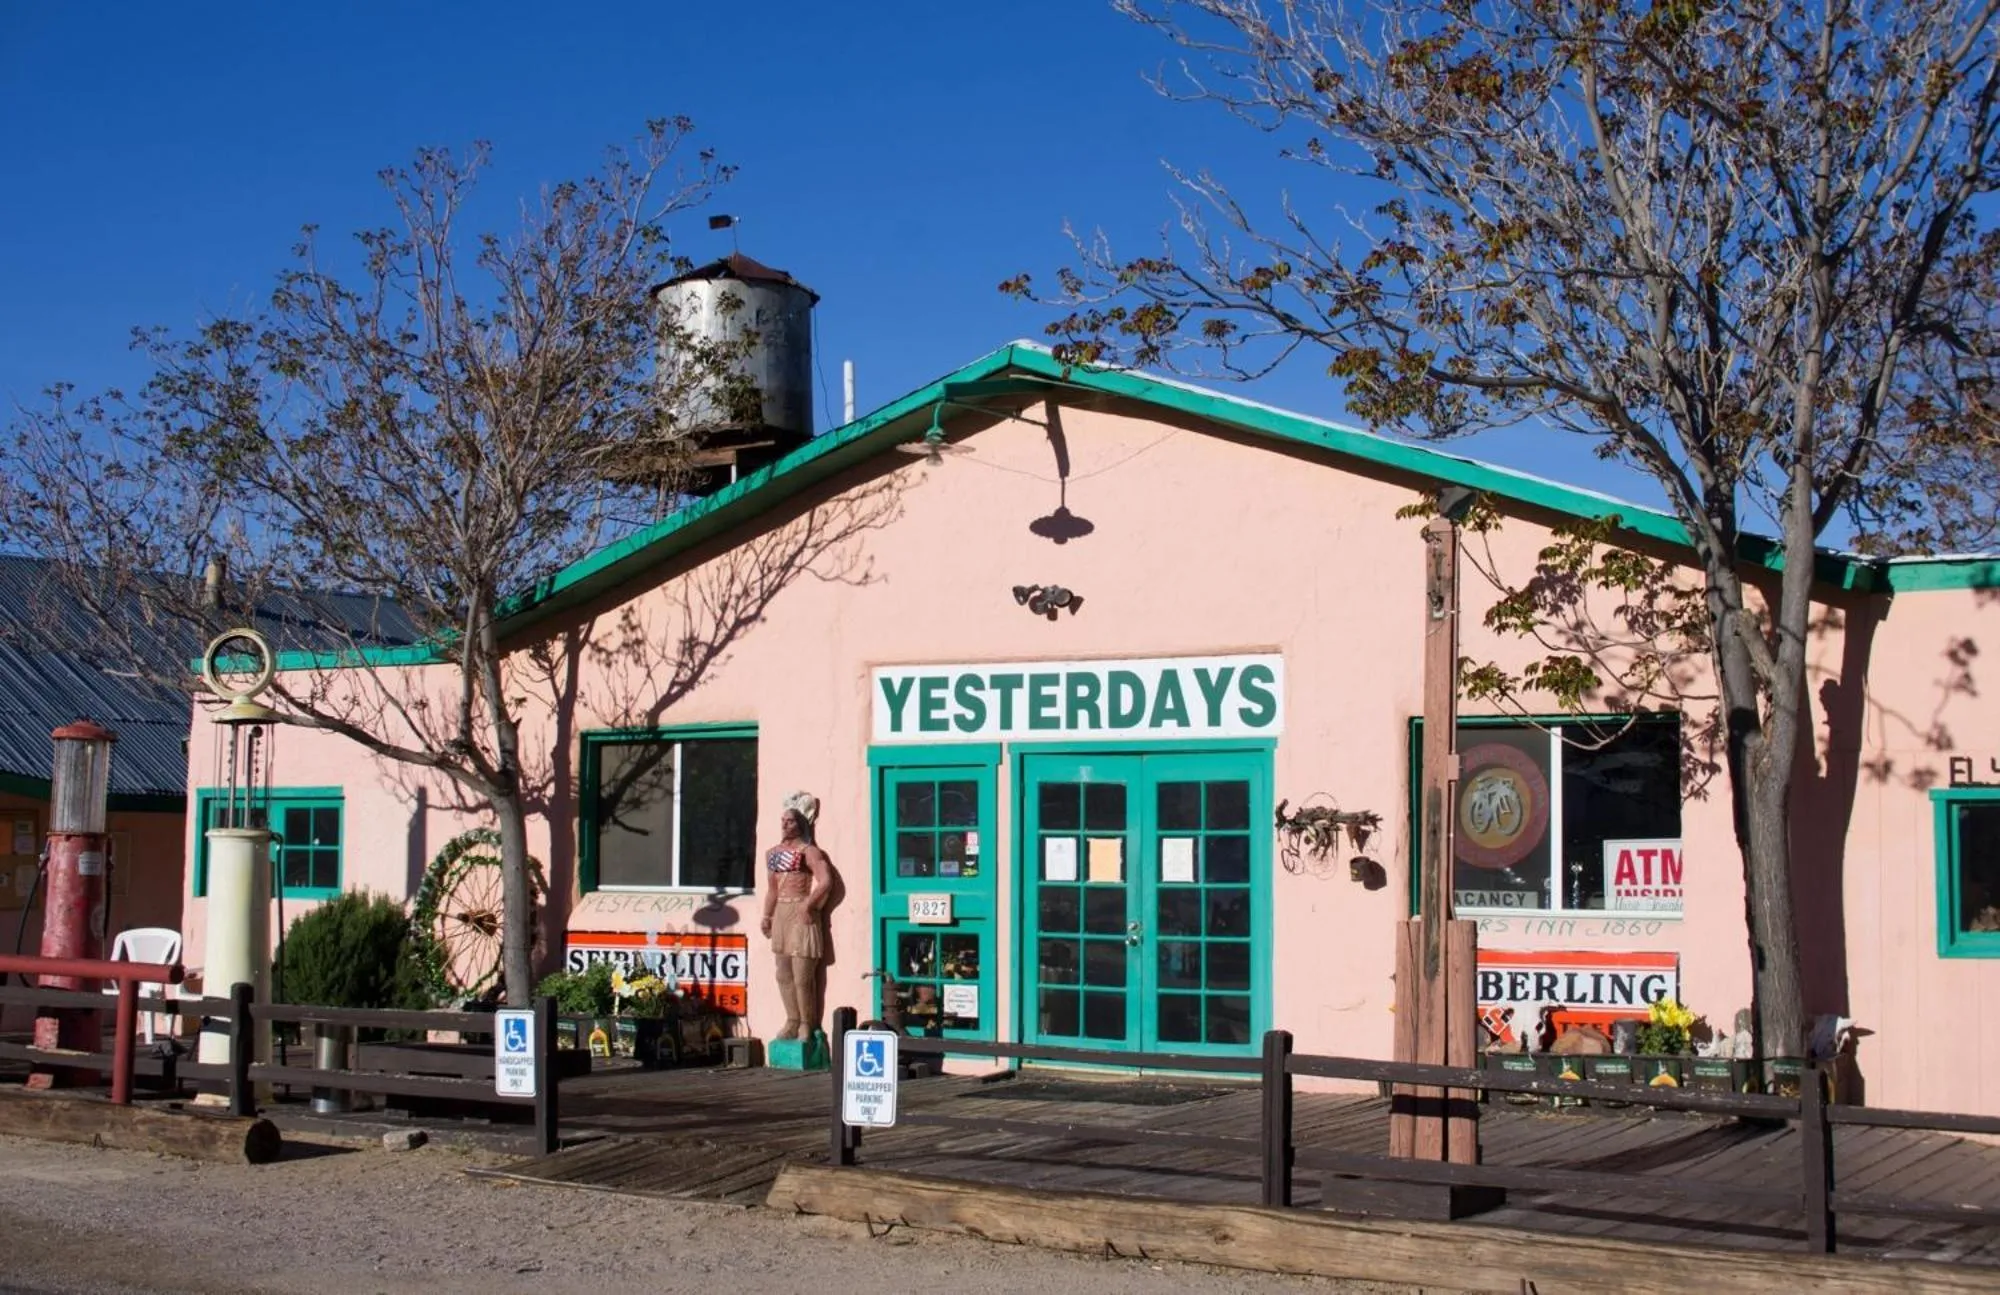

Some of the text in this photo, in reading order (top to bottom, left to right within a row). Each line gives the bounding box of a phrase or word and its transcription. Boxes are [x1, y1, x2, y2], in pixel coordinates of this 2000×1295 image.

[879, 663, 1277, 733] YESTERDAYS
[1614, 848, 1683, 886] ATM
[1615, 887, 1683, 897] INSID
[912, 901, 947, 916] 9827
[1524, 919, 1577, 936] INN
[847, 1082, 892, 1092] HANDICAPPED
[855, 1093, 883, 1104] PARKING
[860, 1107, 877, 1116] ONLY
